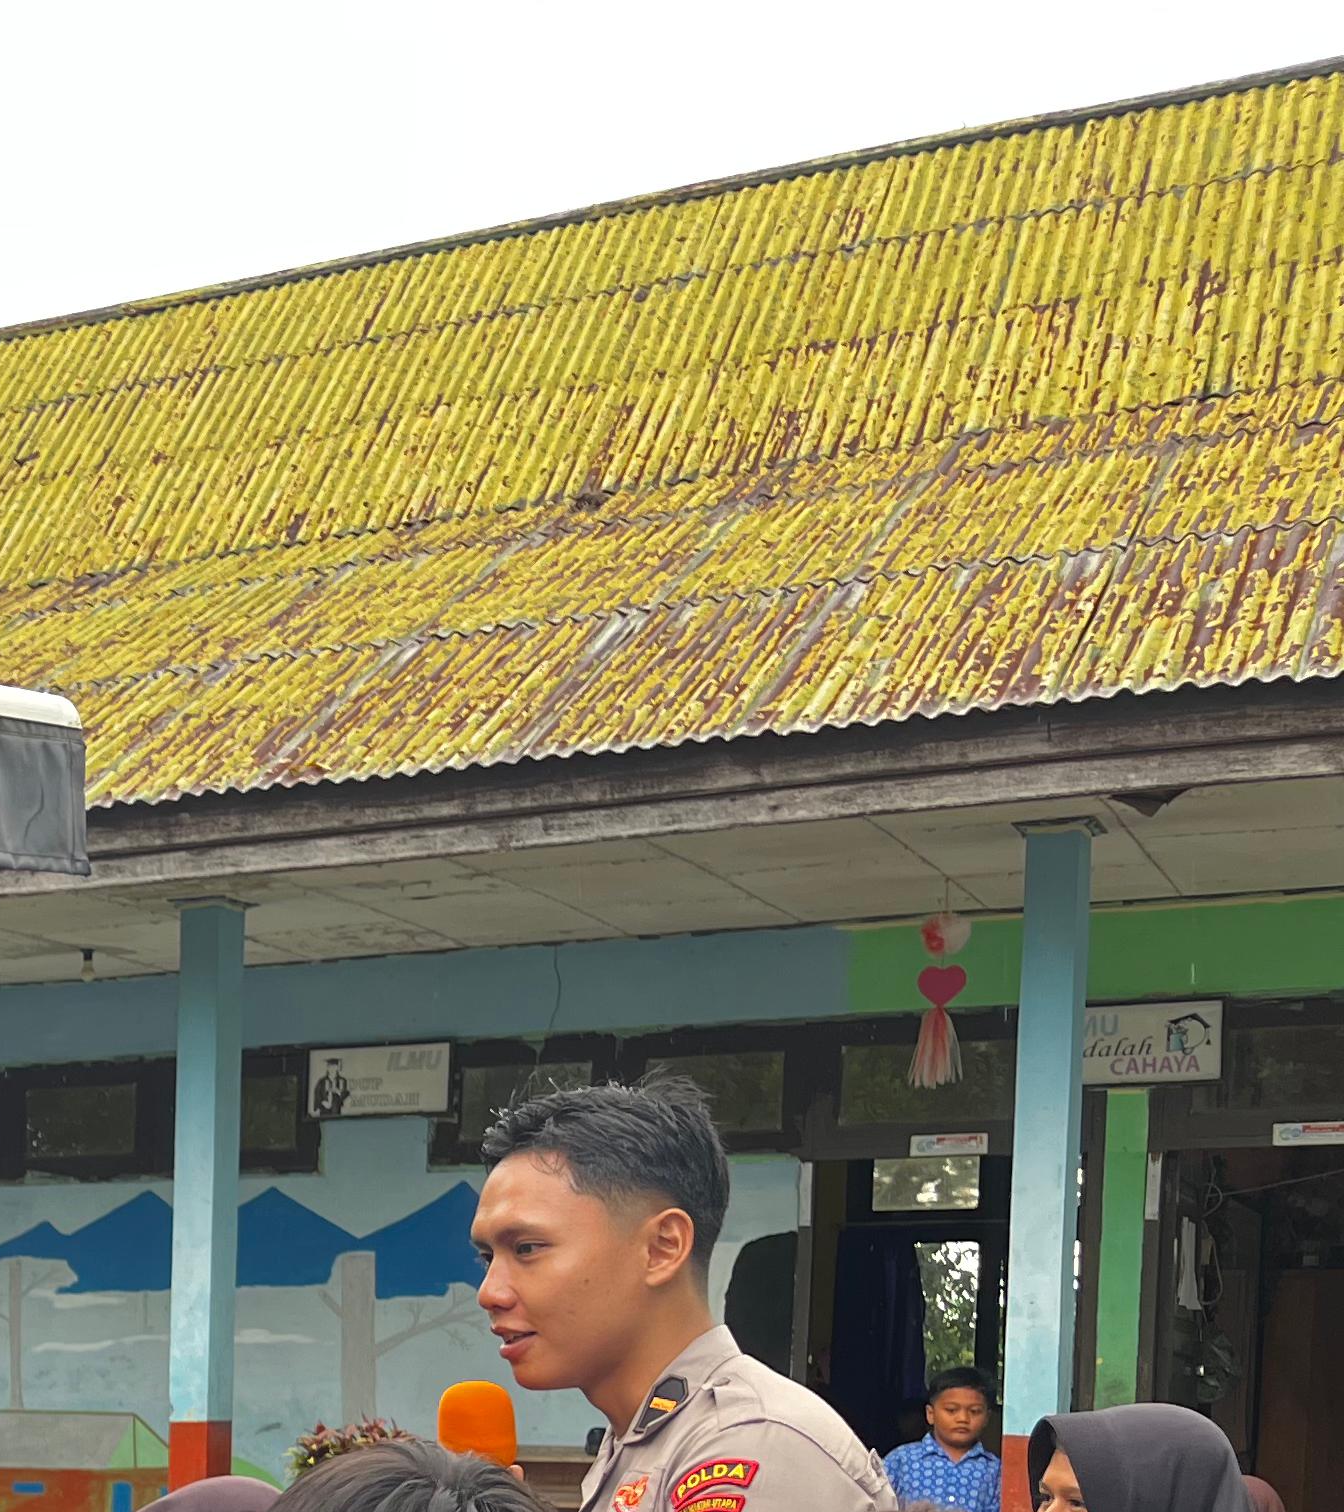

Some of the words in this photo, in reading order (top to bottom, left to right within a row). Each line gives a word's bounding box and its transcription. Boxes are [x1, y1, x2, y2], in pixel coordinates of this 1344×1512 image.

[387, 1050, 442, 1072] ILMU
[1110, 1055, 1200, 1075] CAHAYA
[677, 1463, 744, 1498] POLDA
